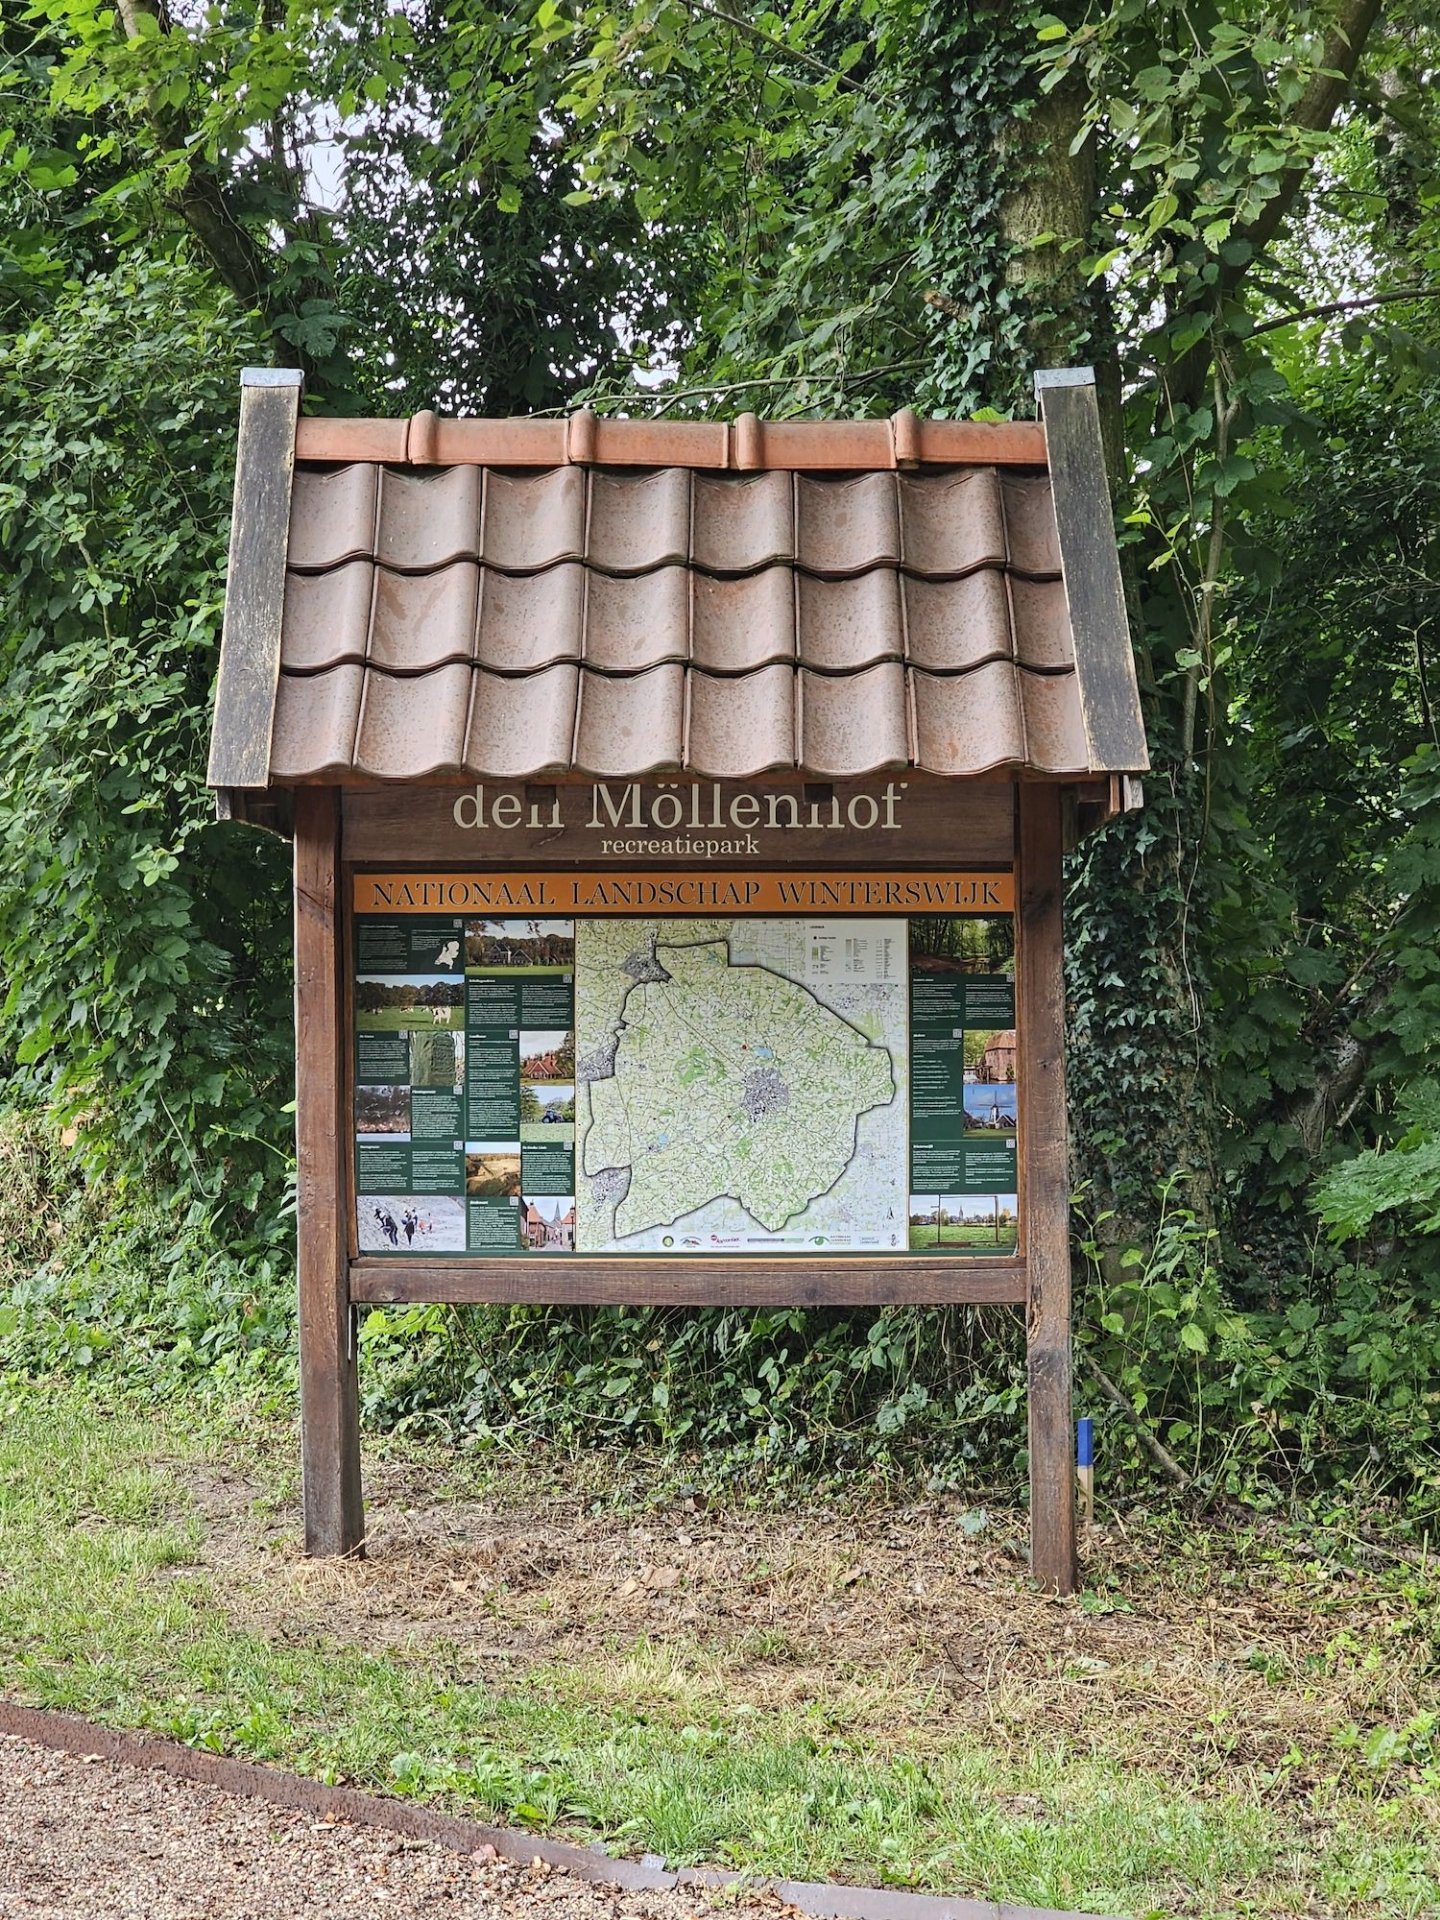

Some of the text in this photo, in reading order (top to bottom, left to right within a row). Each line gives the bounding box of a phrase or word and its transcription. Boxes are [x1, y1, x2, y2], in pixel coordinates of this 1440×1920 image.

[601, 834, 760, 858] recreatiepark
[372, 880, 1003, 907] NATIONAAL LANDSCHAP WINTERSWIJK
